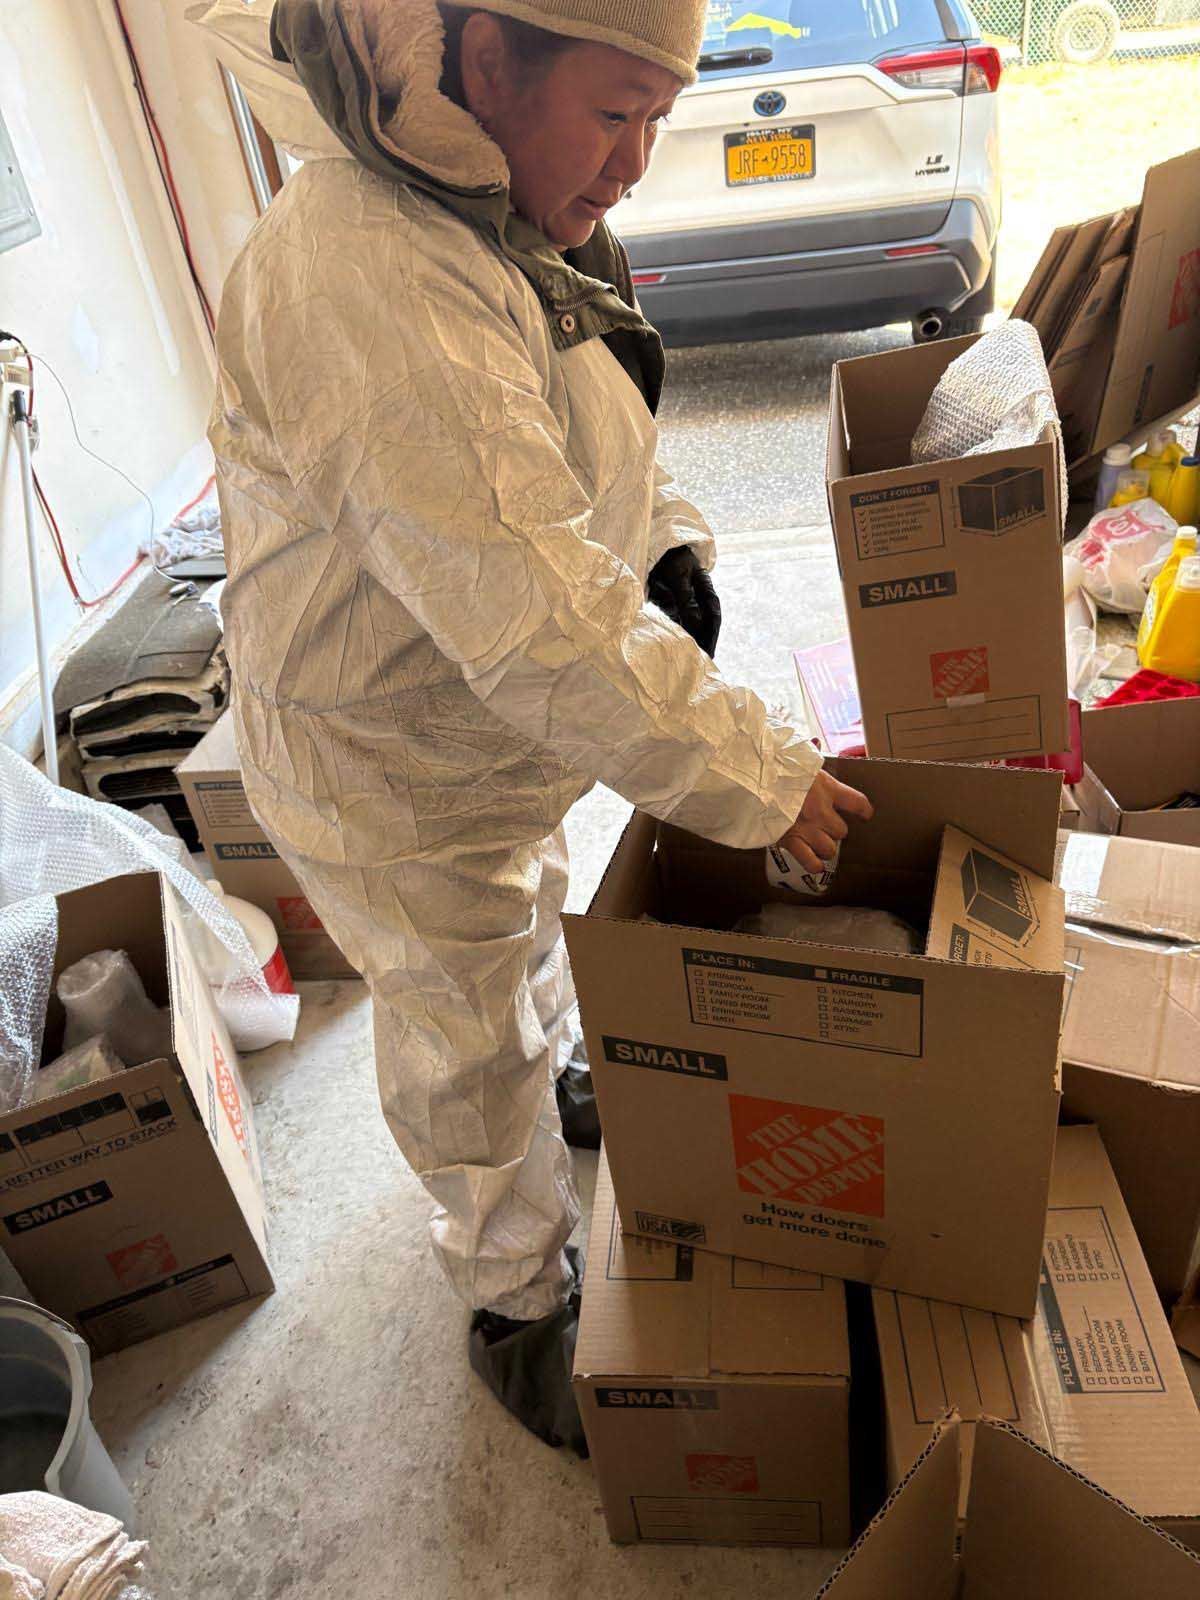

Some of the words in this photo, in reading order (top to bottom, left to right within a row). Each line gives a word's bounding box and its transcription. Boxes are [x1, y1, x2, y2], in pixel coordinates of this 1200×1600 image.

[926, 153, 944, 166] LE
[999, 504, 1040, 530] SMALL
[868, 577, 948, 602] SMALL
[221, 844, 278, 858] SMALL
[1008, 877, 1031, 918] SMALL
[953, 934, 965, 961] RGET:
[691, 952, 736, 968] PLACE
[737, 959, 755, 970] IN:
[708, 980, 753, 992] BEDROOM
[831, 970, 892, 987] FRAGILE
[709, 989, 740, 999] FAMILY
[742, 993, 769, 1003] ROOM
[832, 988, 873, 1000] KITCHEN
[832, 998, 877, 1009] LAUNDRY
[740, 1002, 769, 1012] ROOM
[743, 1010, 770, 1020] ROOM
[833, 1006, 883, 1019] BASEMENT
[833, 1015, 873, 1027] GARAGE
[615, 1042, 717, 1074] SMALL
[746, 1114, 809, 1150] THE
[5, 1158, 66, 1187] BETTER
[69, 1145, 101, 1165] WAY
[105, 1136, 126, 1151] TO
[129, 1117, 177, 1142] STACK
[735, 1113, 884, 1197] HOME
[794, 1154, 885, 1202] DEPOT
[15, 1188, 103, 1228] SMALL
[761, 1202, 805, 1221] How
[810, 1211, 870, 1232] doers
[640, 1215, 673, 1234] USA
[743, 1213, 774, 1226] get
[779, 1220, 831, 1239] more
[834, 1230, 887, 1249] done
[1093, 1249, 1104, 1269] ATTIC
[1093, 1320, 1105, 1343] ROOM
[1104, 1321, 1118, 1345] ROOM
[1115, 1320, 1129, 1343] ROOM
[1074, 1336, 1090, 1373] PRIMARY
[1084, 1331, 1102, 1373] BEDROOM
[1099, 1345, 1115, 1373] FAMILY
[1112, 1345, 1127, 1373] LIVING
[1123, 1344, 1138, 1372] DINING
[1137, 1350, 1150, 1372] BATH
[1055, 1346, 1075, 1385] PLACE
[608, 1391, 706, 1407] SMALL
